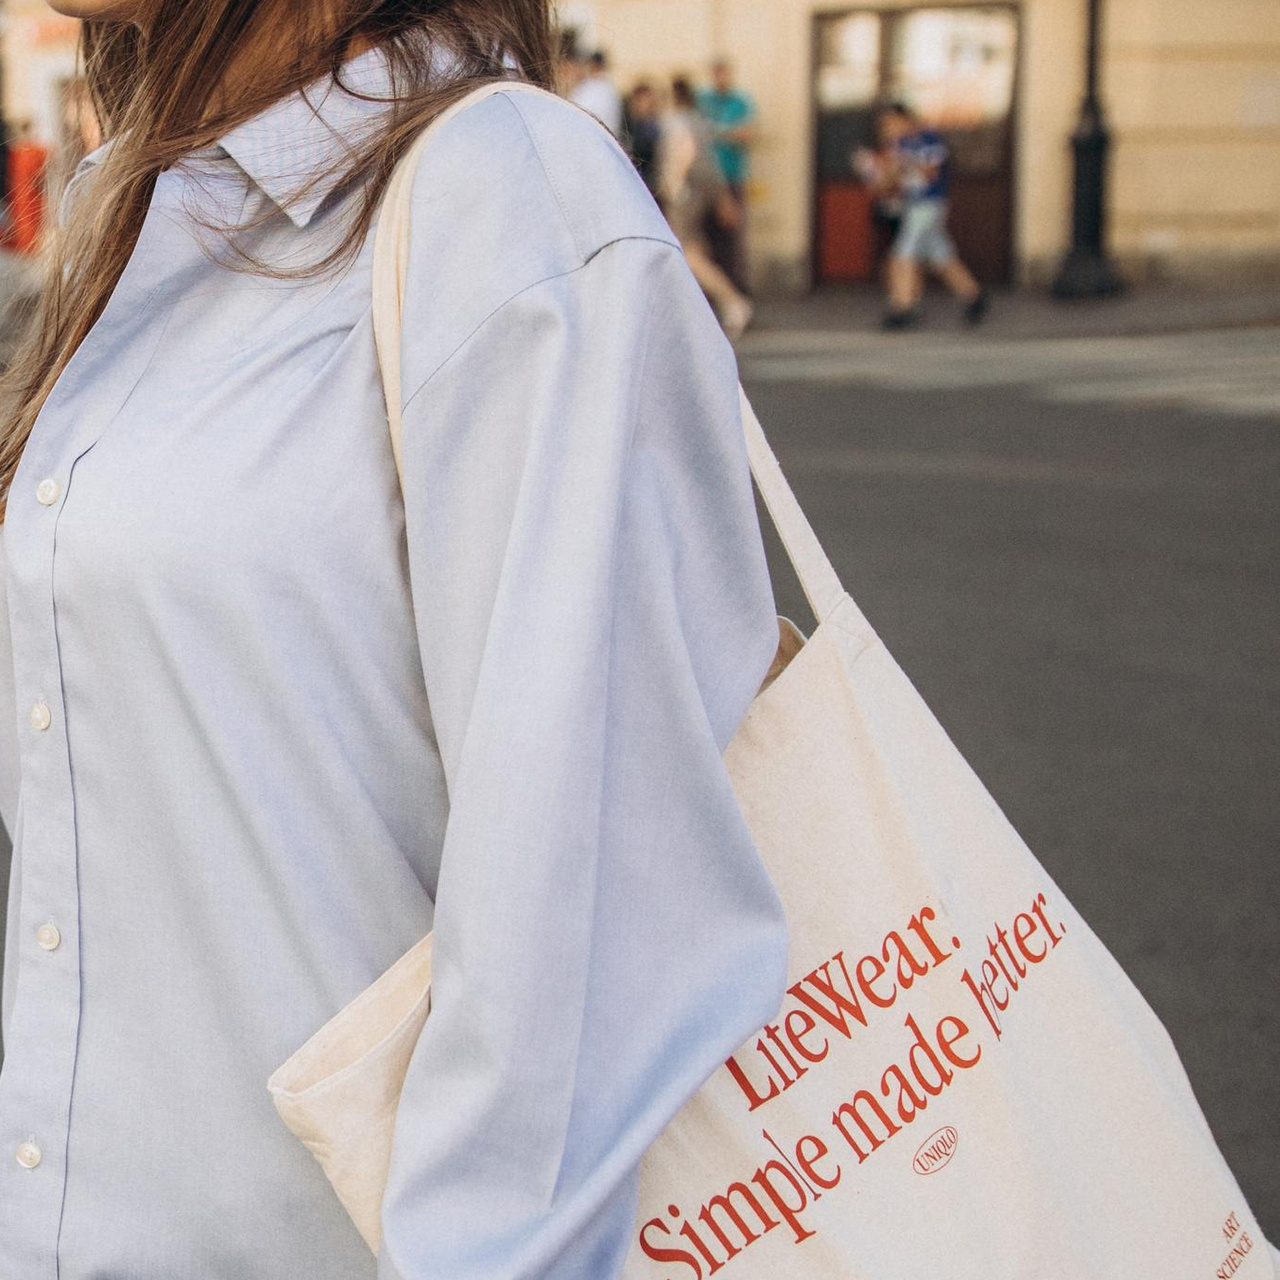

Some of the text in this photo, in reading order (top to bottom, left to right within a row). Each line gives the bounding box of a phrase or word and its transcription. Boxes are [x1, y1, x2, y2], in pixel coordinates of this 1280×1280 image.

[724, 906, 961, 1113] LifeWear.
[831, 1012, 982, 1165] made
[960, 892, 1067, 1042] better.
[916, 1128, 957, 1173] UNIQLO
[1222, 1211, 1240, 1244] ART
